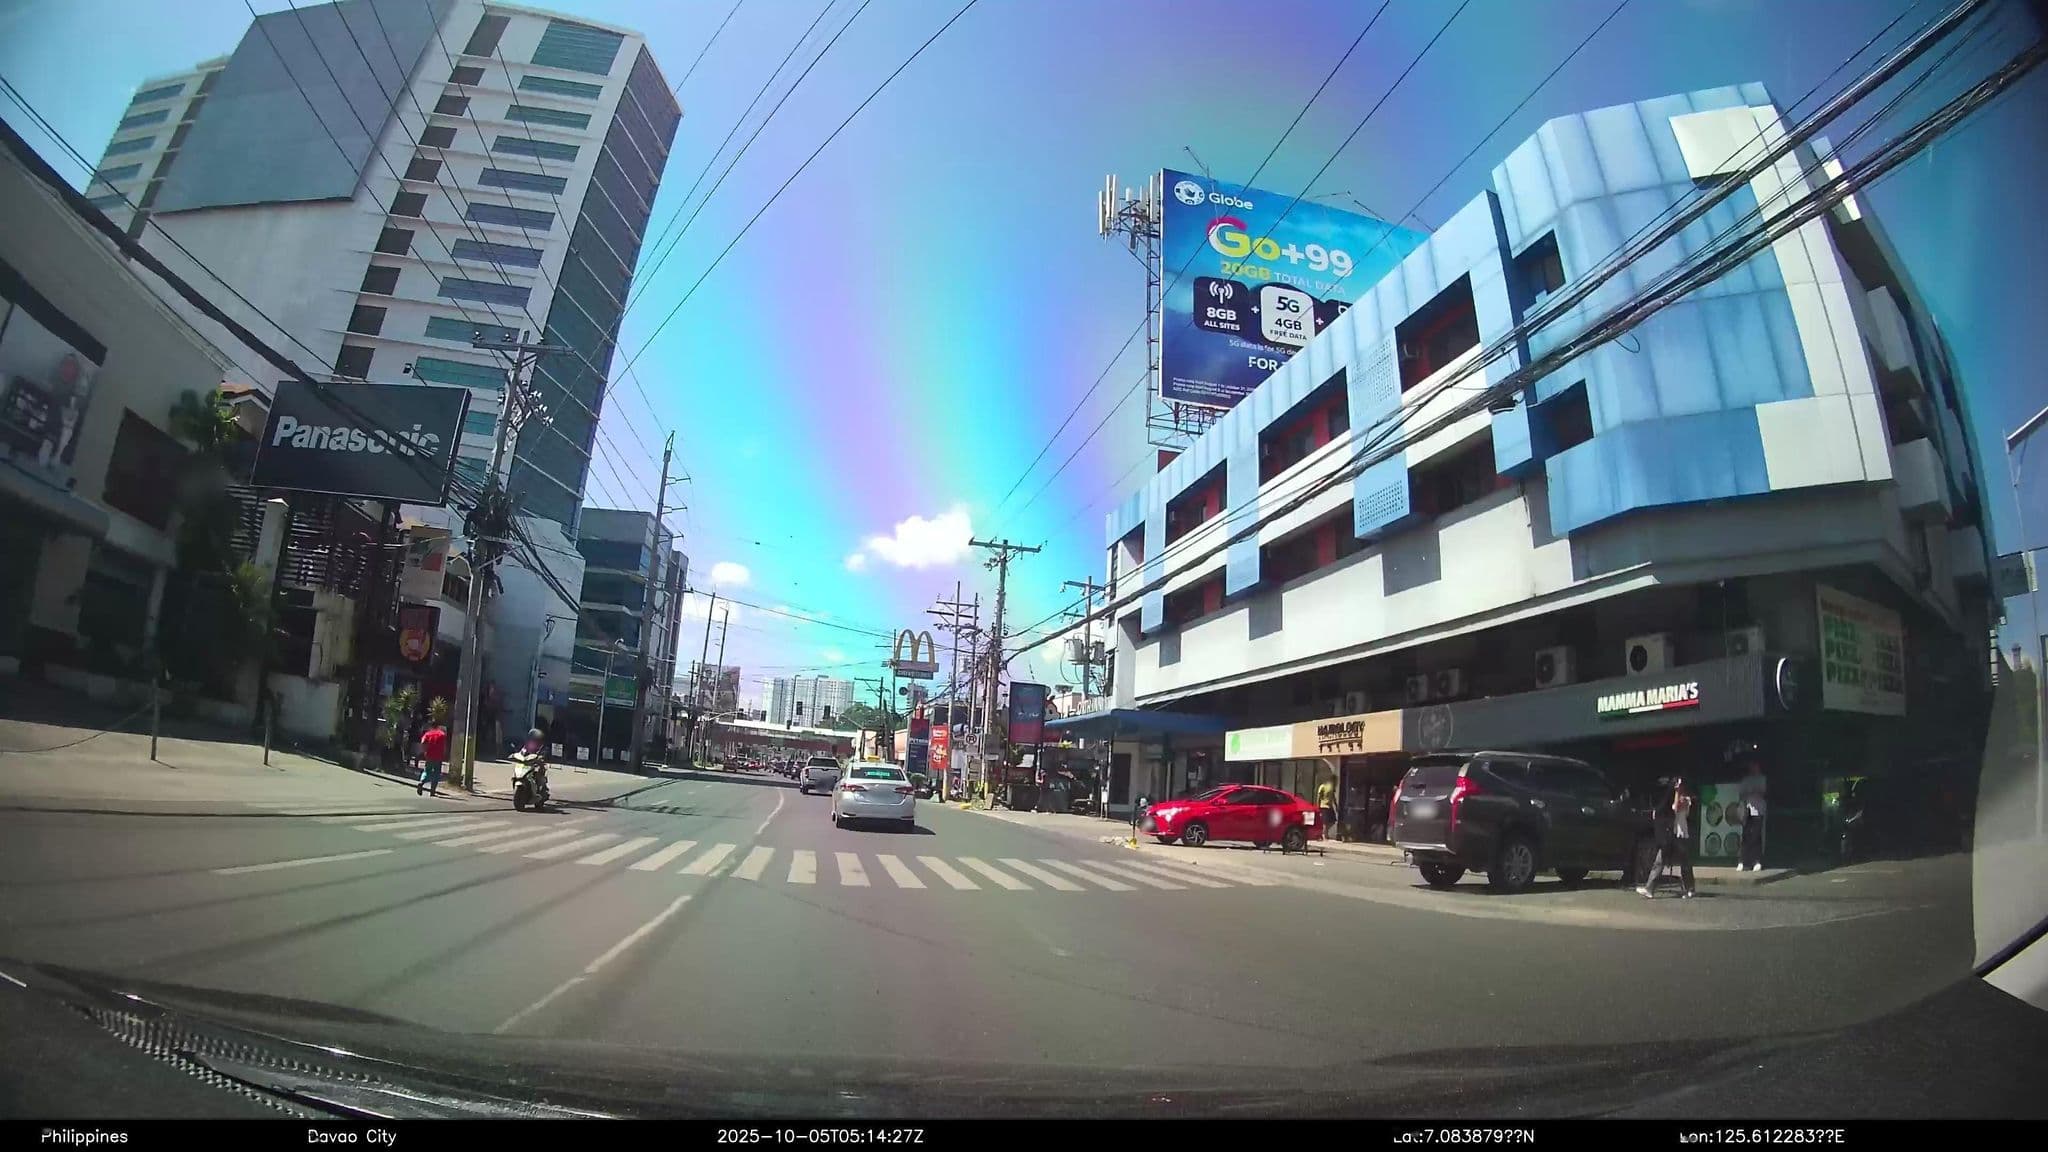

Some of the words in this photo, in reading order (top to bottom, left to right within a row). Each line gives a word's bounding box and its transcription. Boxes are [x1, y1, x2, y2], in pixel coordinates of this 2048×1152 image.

[1209, 193, 1253, 210] Globe
[1206, 216, 1353, 277] Go+99
[1274, 272, 1312, 288] TOTAL
[1276, 296, 1300, 312] 5G
[1206, 307, 1237, 321] 8GB
[1204, 320, 1219, 328] ALL
[1220, 322, 1240, 331] SITES
[1275, 318, 1302, 331] 4GB
[1270, 329, 1286, 338] FREE
[1289, 332, 1307, 340] DATA
[1248, 356, 1278, 371] FOR
[272, 416, 440, 458] Panasonic
[1597, 690, 1646, 713] MAMMA
[1646, 682, 1699, 705] MARIA'S
